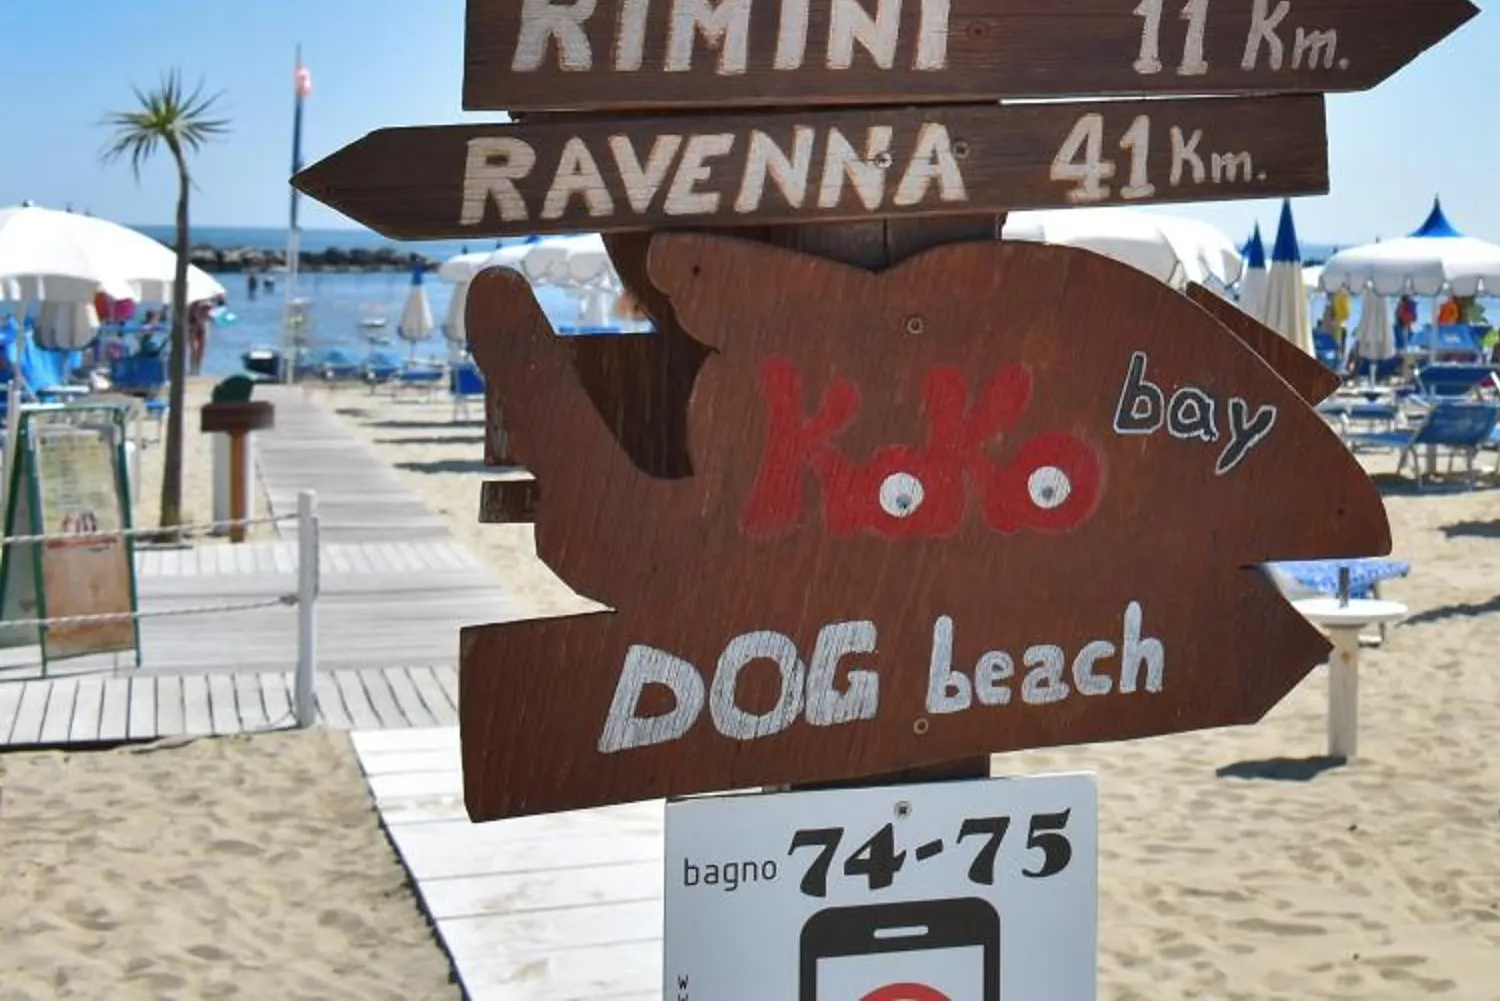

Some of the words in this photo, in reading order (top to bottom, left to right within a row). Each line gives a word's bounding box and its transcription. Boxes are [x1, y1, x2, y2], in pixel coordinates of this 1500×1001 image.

[459, 121, 968, 226] RAVENNA
[1049, 112, 1155, 202] 41
[1168, 126, 1268, 186] Km.
[1113, 351, 1277, 476] bay
[598, 620, 879, 753] DOG
[926, 601, 1166, 715] beach
[683, 857, 778, 892] bagno
[787, 807, 1073, 899] 74-75
